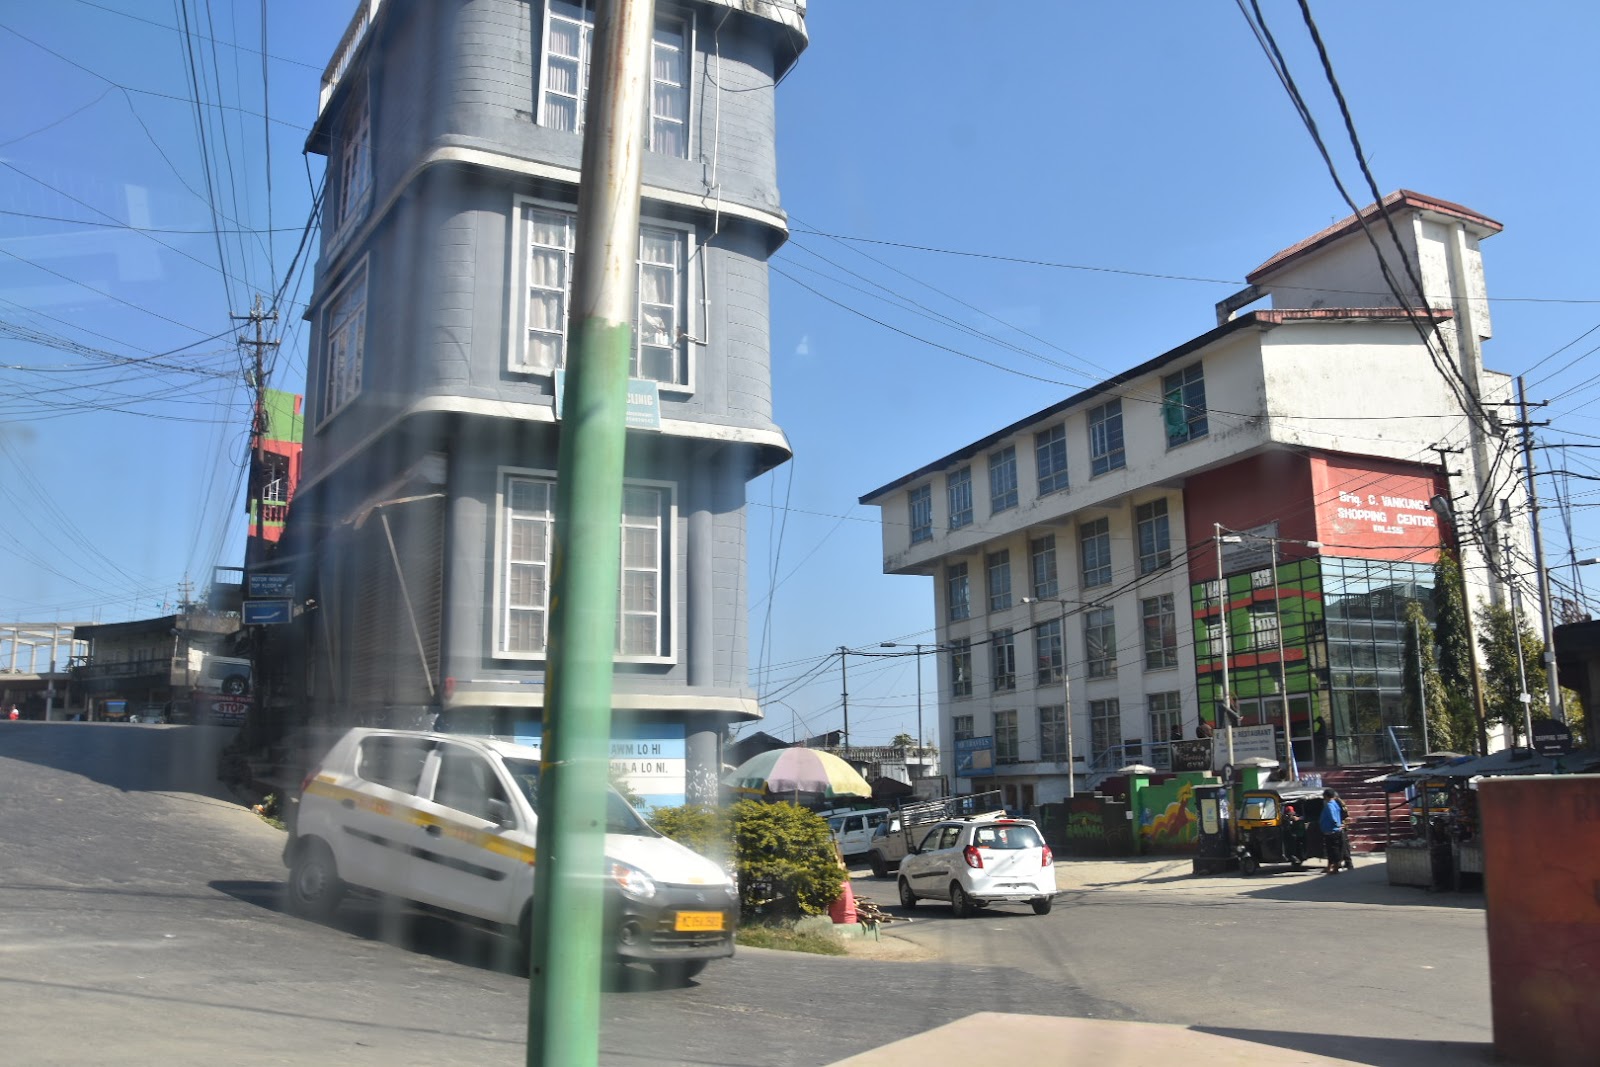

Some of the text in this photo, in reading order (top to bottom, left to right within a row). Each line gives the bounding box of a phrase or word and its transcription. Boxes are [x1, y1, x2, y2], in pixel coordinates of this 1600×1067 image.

[625, 393, 653, 406] CLINIC
[1337, 508, 1436, 527] SHOPPING CENTRE
[218, 703, 245, 712] STOP
[1238, 728, 1272, 738] RESTAURANT
[610, 743, 661, 755] AWM LO HI
[641, 762, 652, 774] LO
